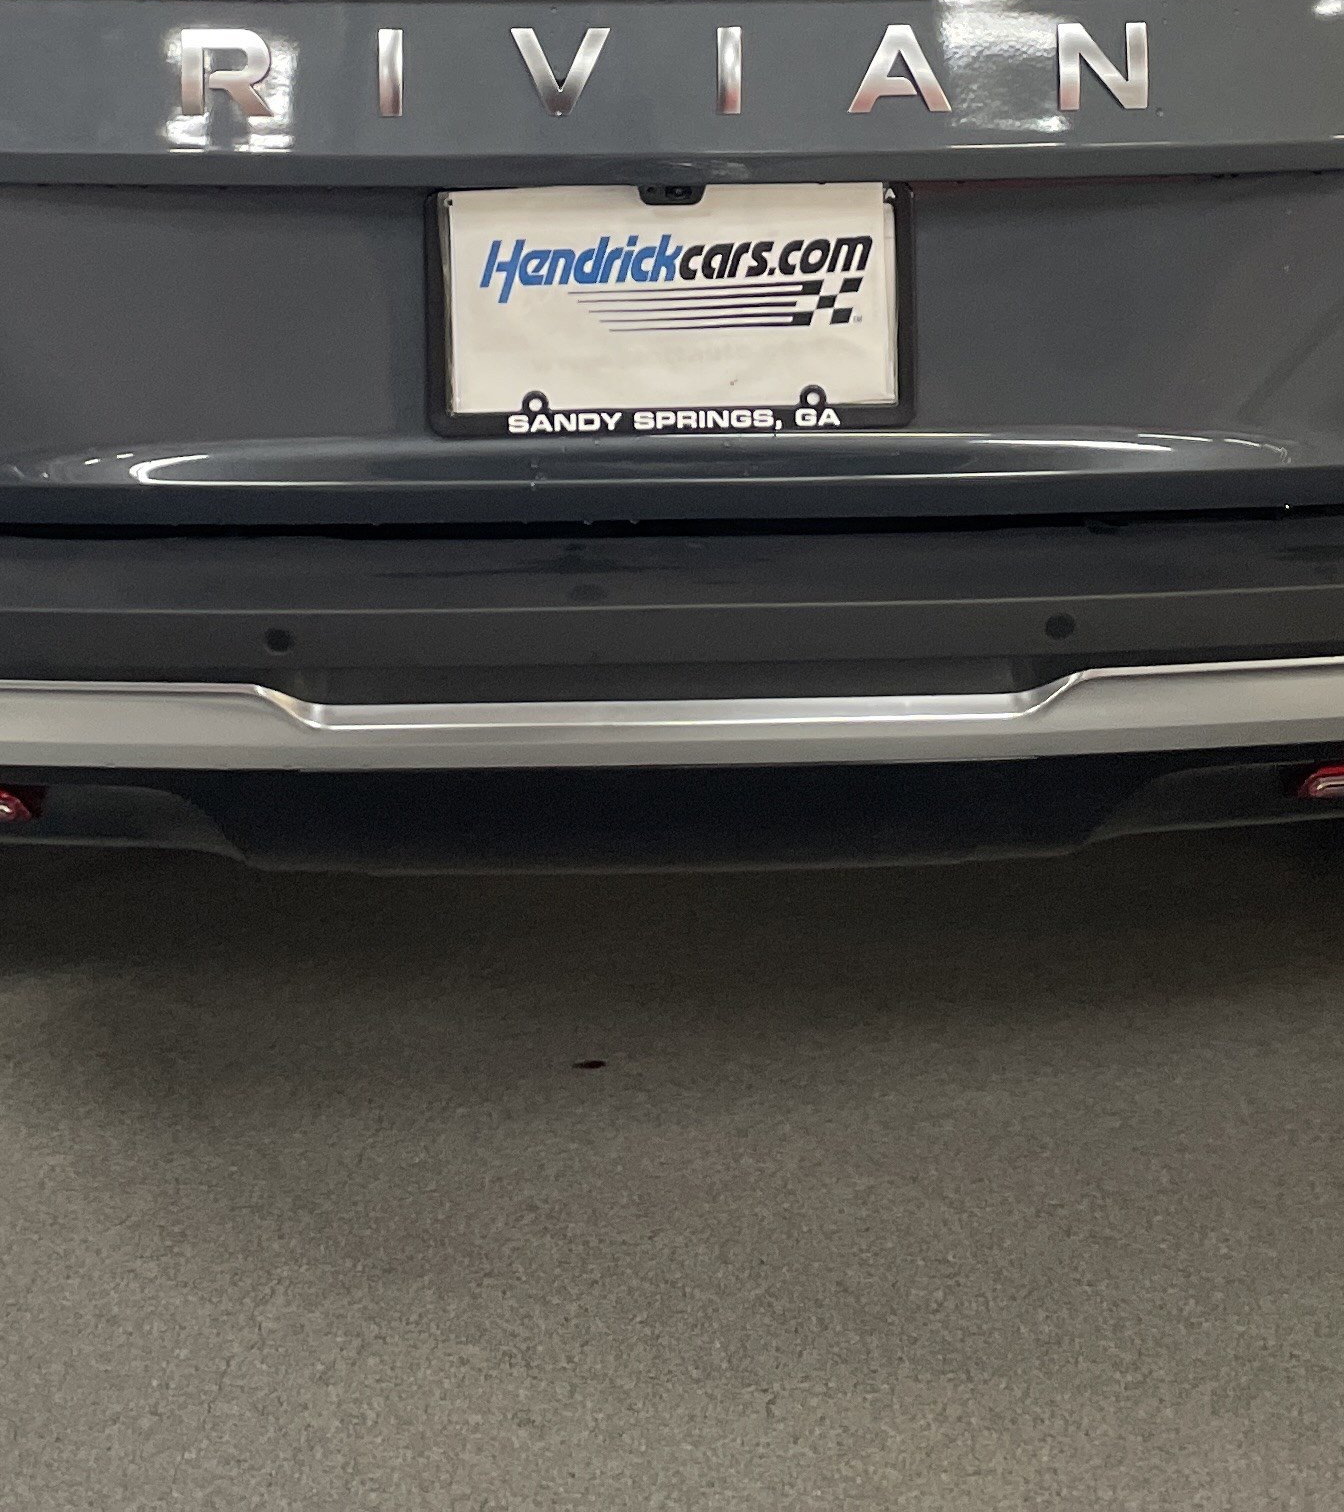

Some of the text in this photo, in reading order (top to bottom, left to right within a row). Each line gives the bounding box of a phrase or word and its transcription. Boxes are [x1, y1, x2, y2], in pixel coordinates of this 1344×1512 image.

[179, 21, 1149, 117] RIVIAN
[479, 234, 874, 303] Hendrickcars.com
[508, 408, 841, 434] SANDY SPRINGS, GA
